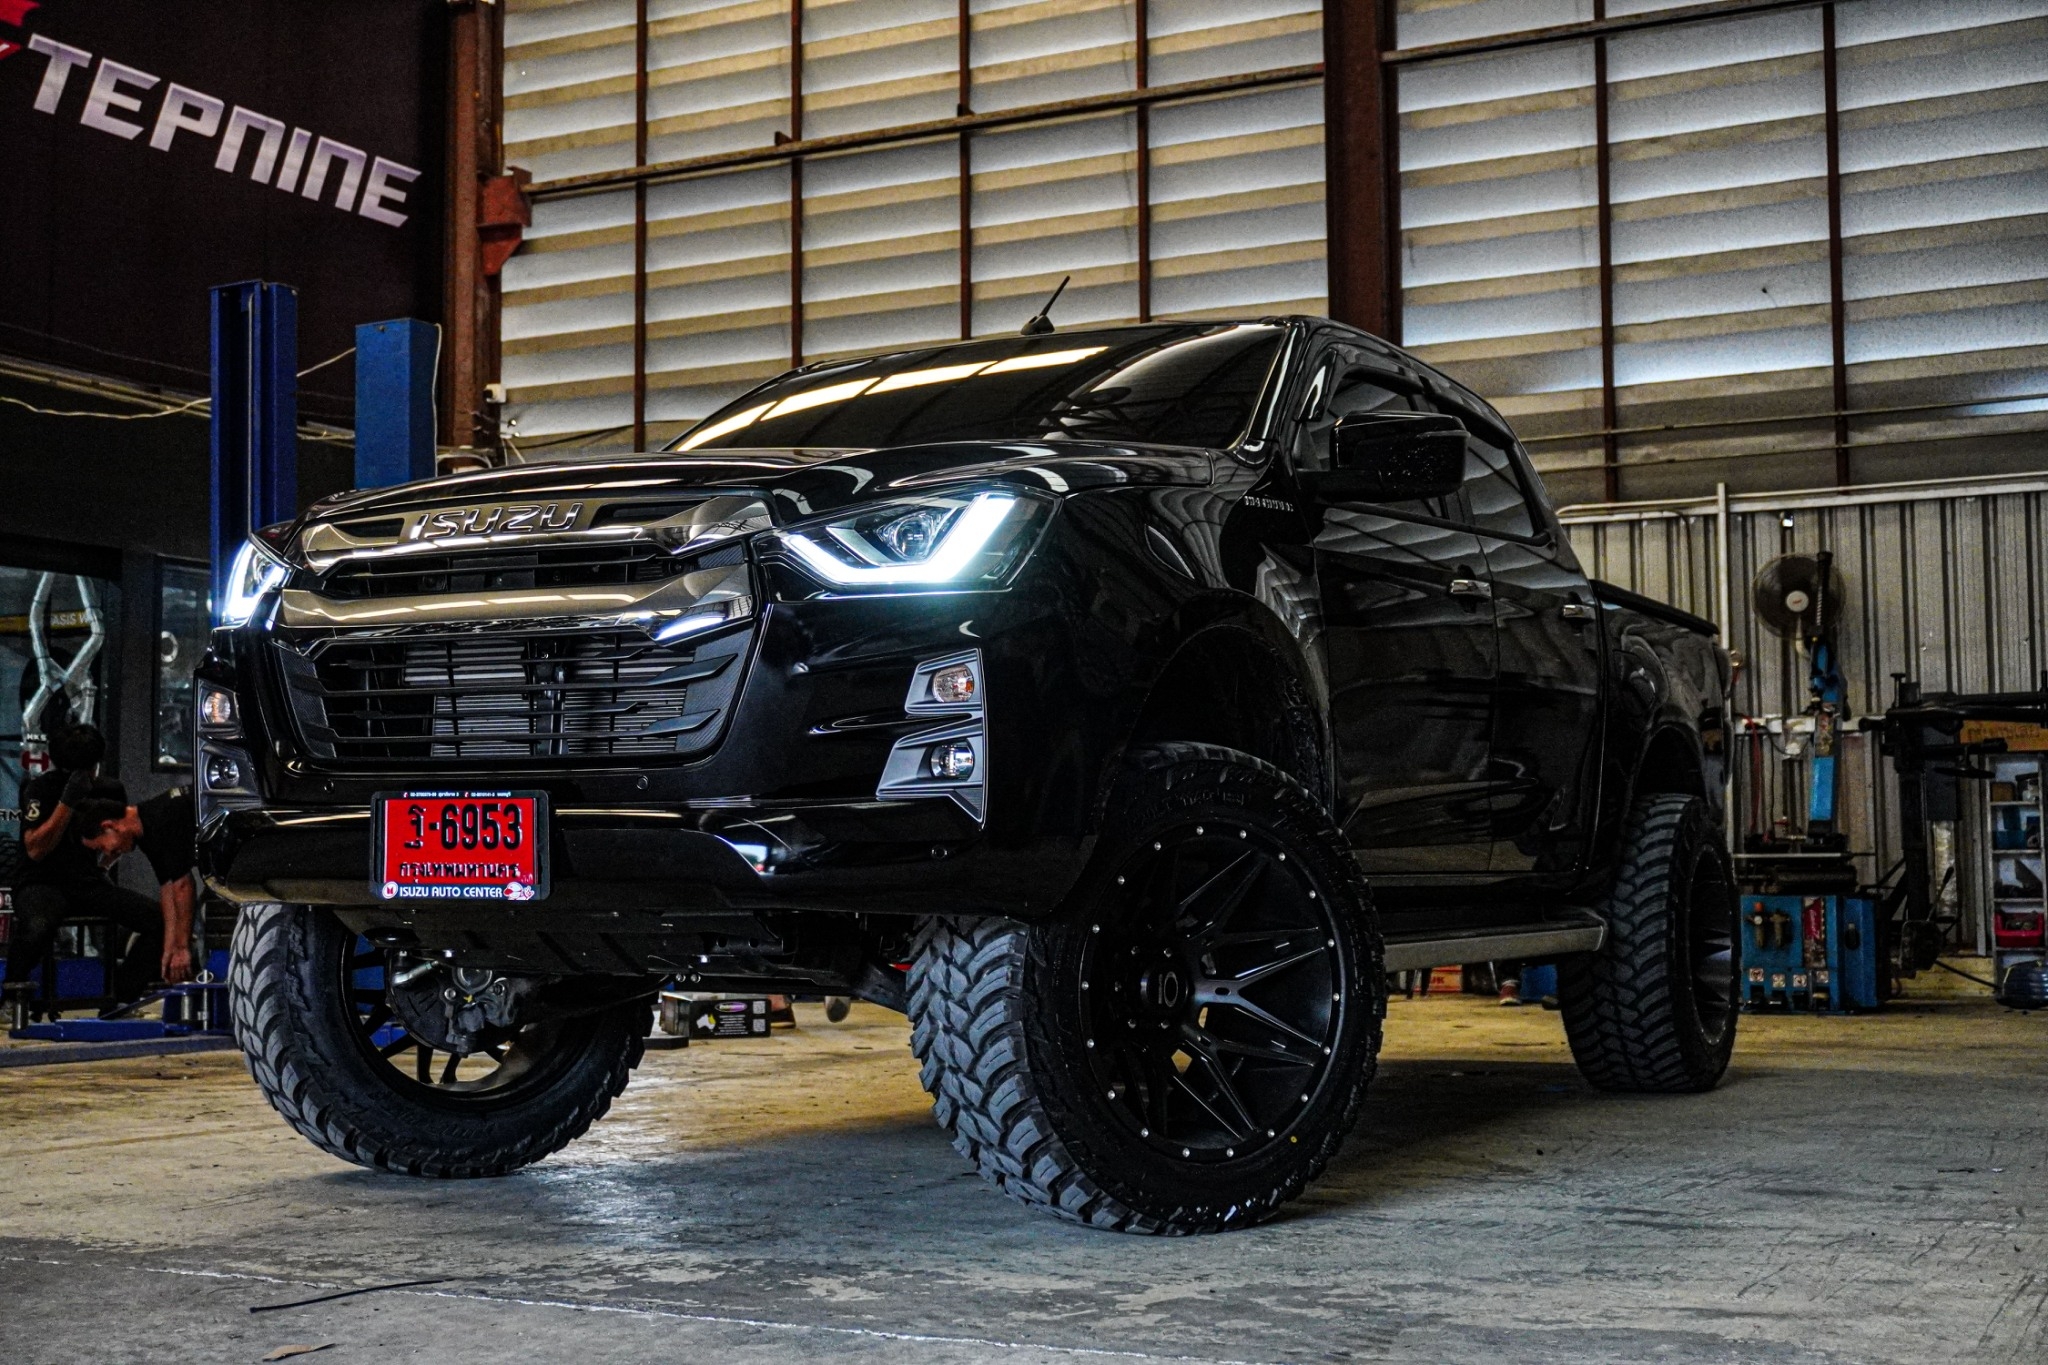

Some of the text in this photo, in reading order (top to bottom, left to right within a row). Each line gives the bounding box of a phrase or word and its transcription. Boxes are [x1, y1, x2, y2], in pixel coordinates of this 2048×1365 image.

[410, 502, 584, 541] ISUZU
[400, 861, 520, 884] กรุงเทพมหานคร
[400, 886, 503, 898] ISUZU AUTO CENTER
